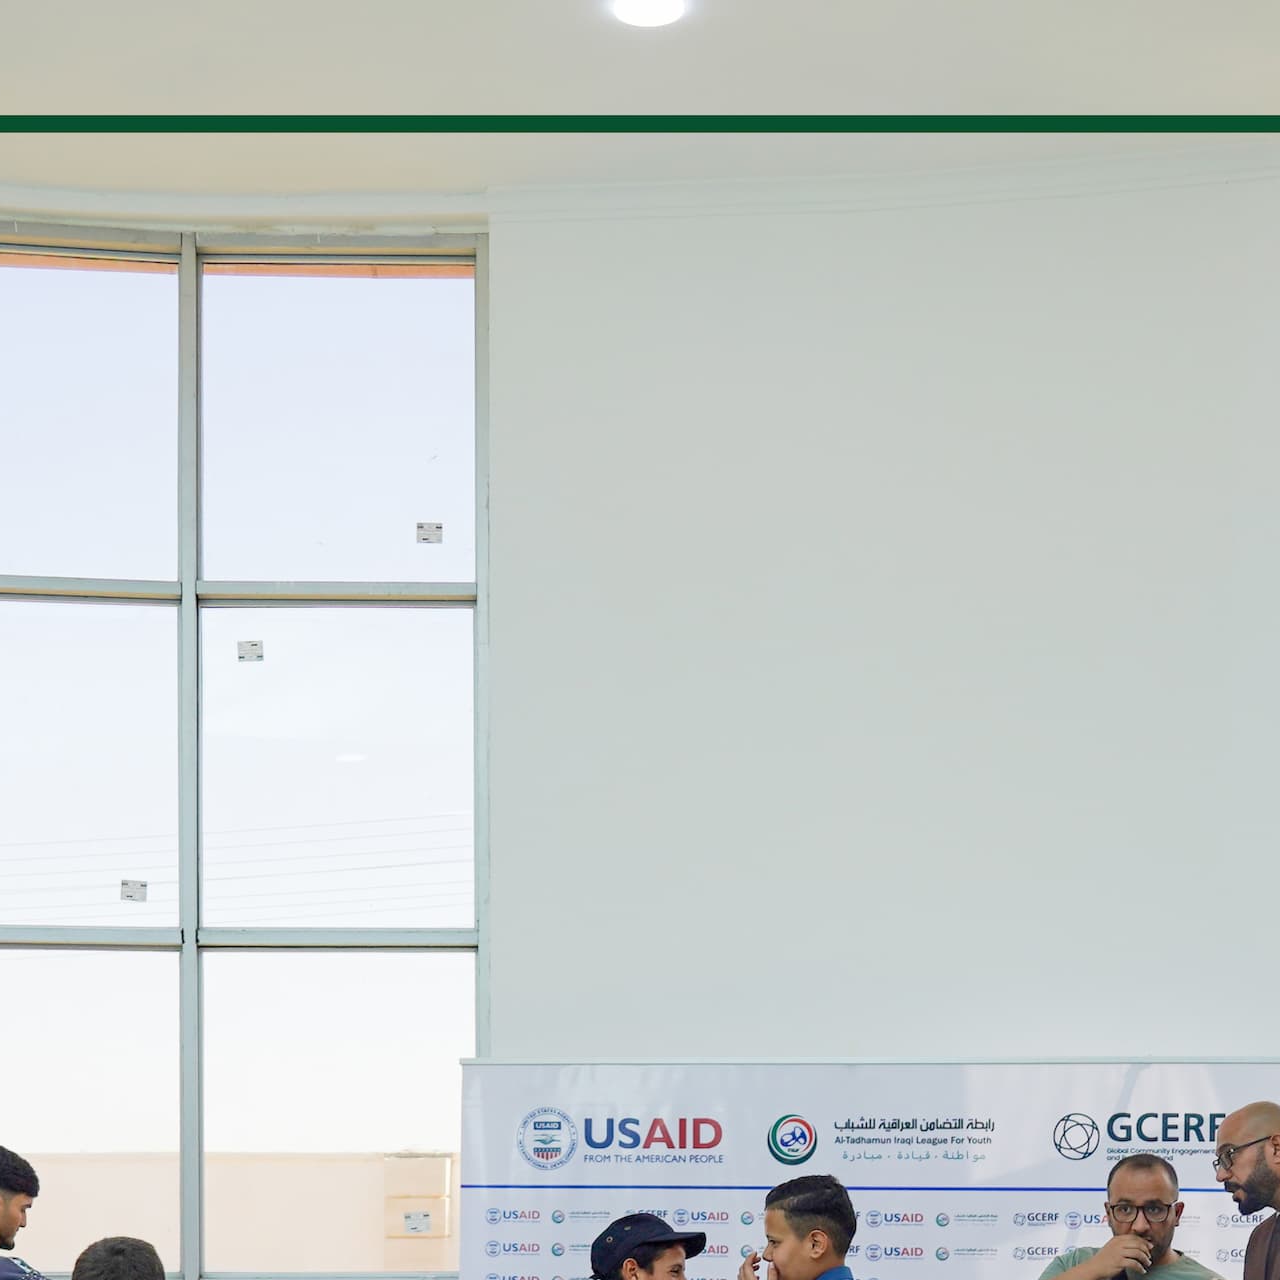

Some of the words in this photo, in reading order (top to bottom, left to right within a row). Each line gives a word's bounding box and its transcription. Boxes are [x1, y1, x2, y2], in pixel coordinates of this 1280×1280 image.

[834, 1117, 875, 1132] للشباب
[878, 1118, 917, 1132] العراقية
[920, 1118, 963, 1132] التضامن
[966, 1119, 994, 1132] رابطة
[1107, 1113, 1225, 1142] GCERF
[584, 1118, 722, 1149] USAID
[835, 1136, 892, 1144] Al-Tadhamun
[894, 1136, 914, 1146] Iraqi
[916, 1136, 948, 1146] League
[951, 1136, 964, 1144] For
[967, 1136, 991, 1144] Youth
[584, 1154, 611, 1163] FROM
[615, 1154, 632, 1163] THE
[635, 1155, 686, 1163] AMERICAN
[689, 1155, 723, 1163] PEOPLE
[503, 1210, 540, 1220] USAID
[691, 1212, 728, 1221] USAID
[884, 1213, 923, 1223] USAID
[1027, 1212, 1059, 1222] GCERF
[1084, 1214, 1108, 1224] USA
[503, 1243, 540, 1253] USAID
[884, 1247, 923, 1256] USAID
[1027, 1246, 1058, 1256] GCERF
